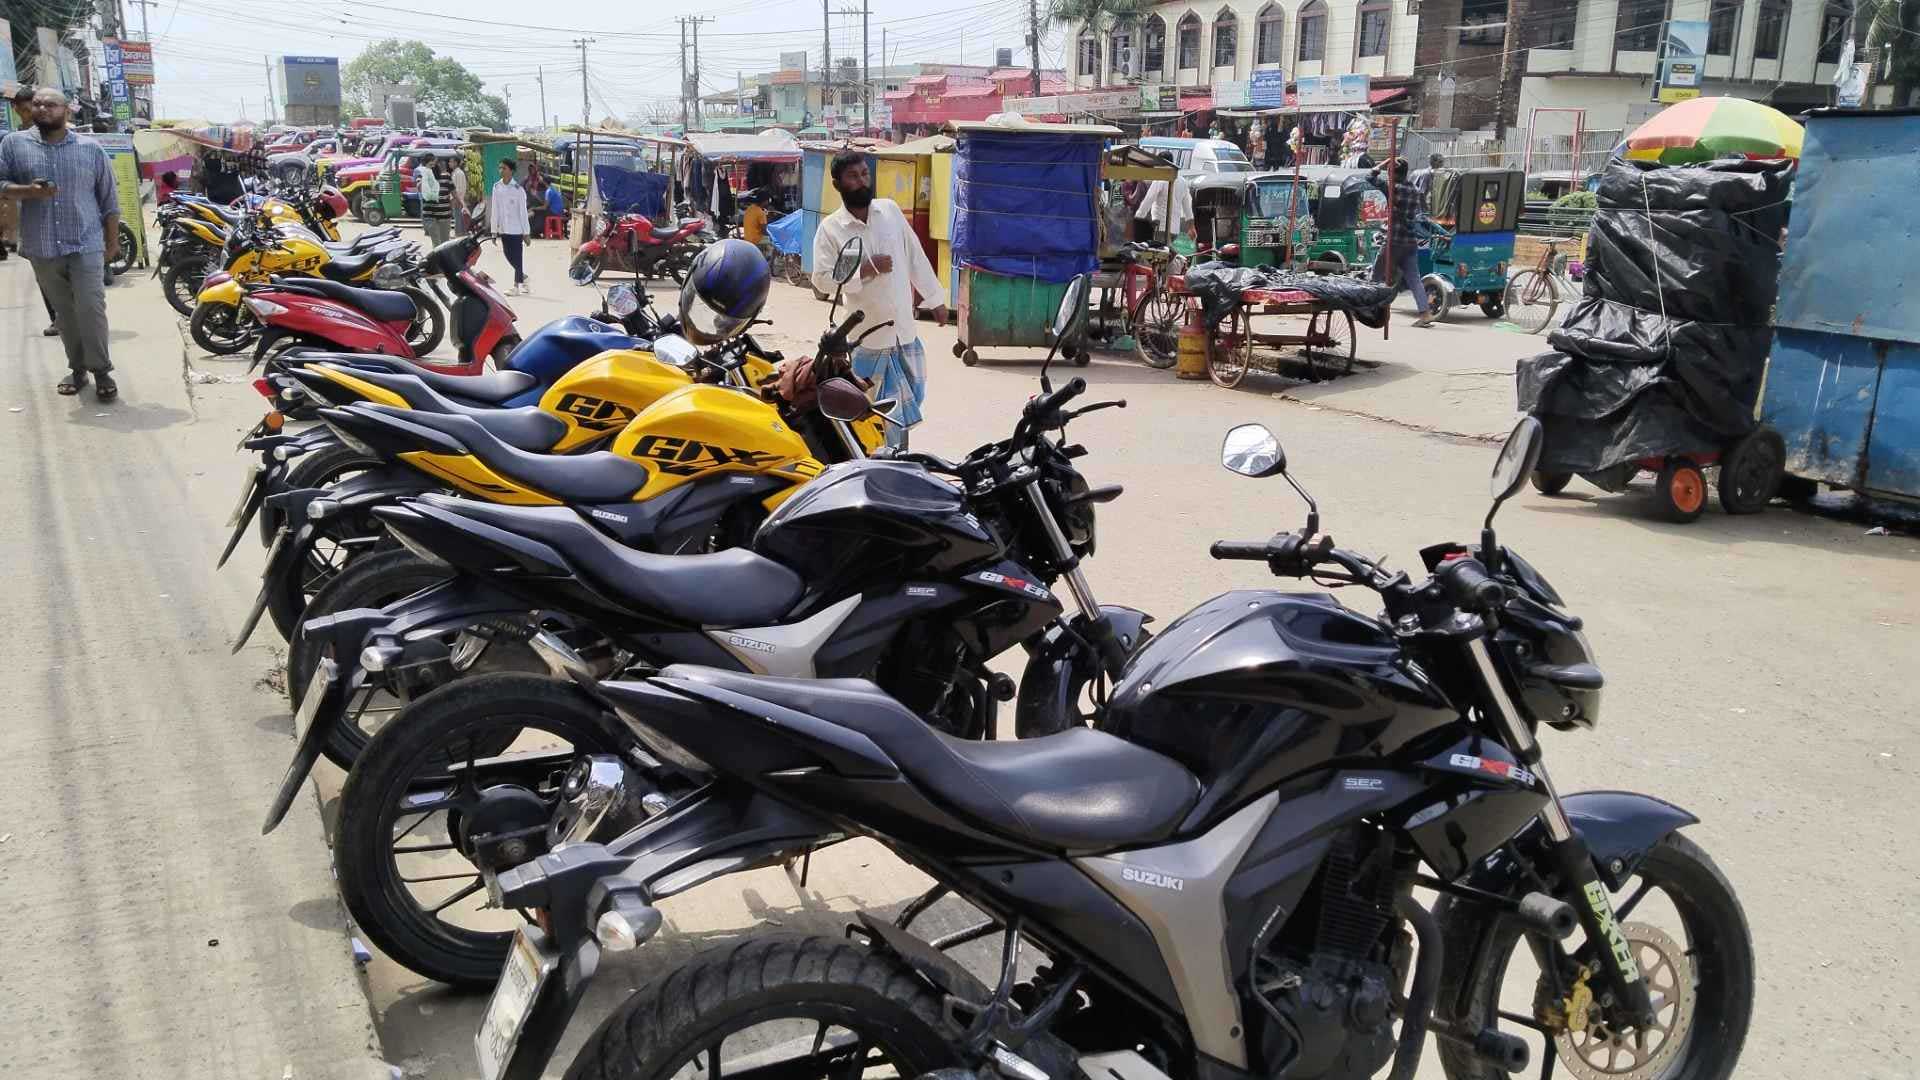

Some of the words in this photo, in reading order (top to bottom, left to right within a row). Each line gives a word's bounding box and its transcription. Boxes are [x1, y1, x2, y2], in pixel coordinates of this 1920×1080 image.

[592, 509, 628, 523] SUZUKI
[729, 635, 777, 654] SUZUKI
[1343, 776, 1384, 788] SEP
[1121, 867, 1184, 891] SUZUKI
